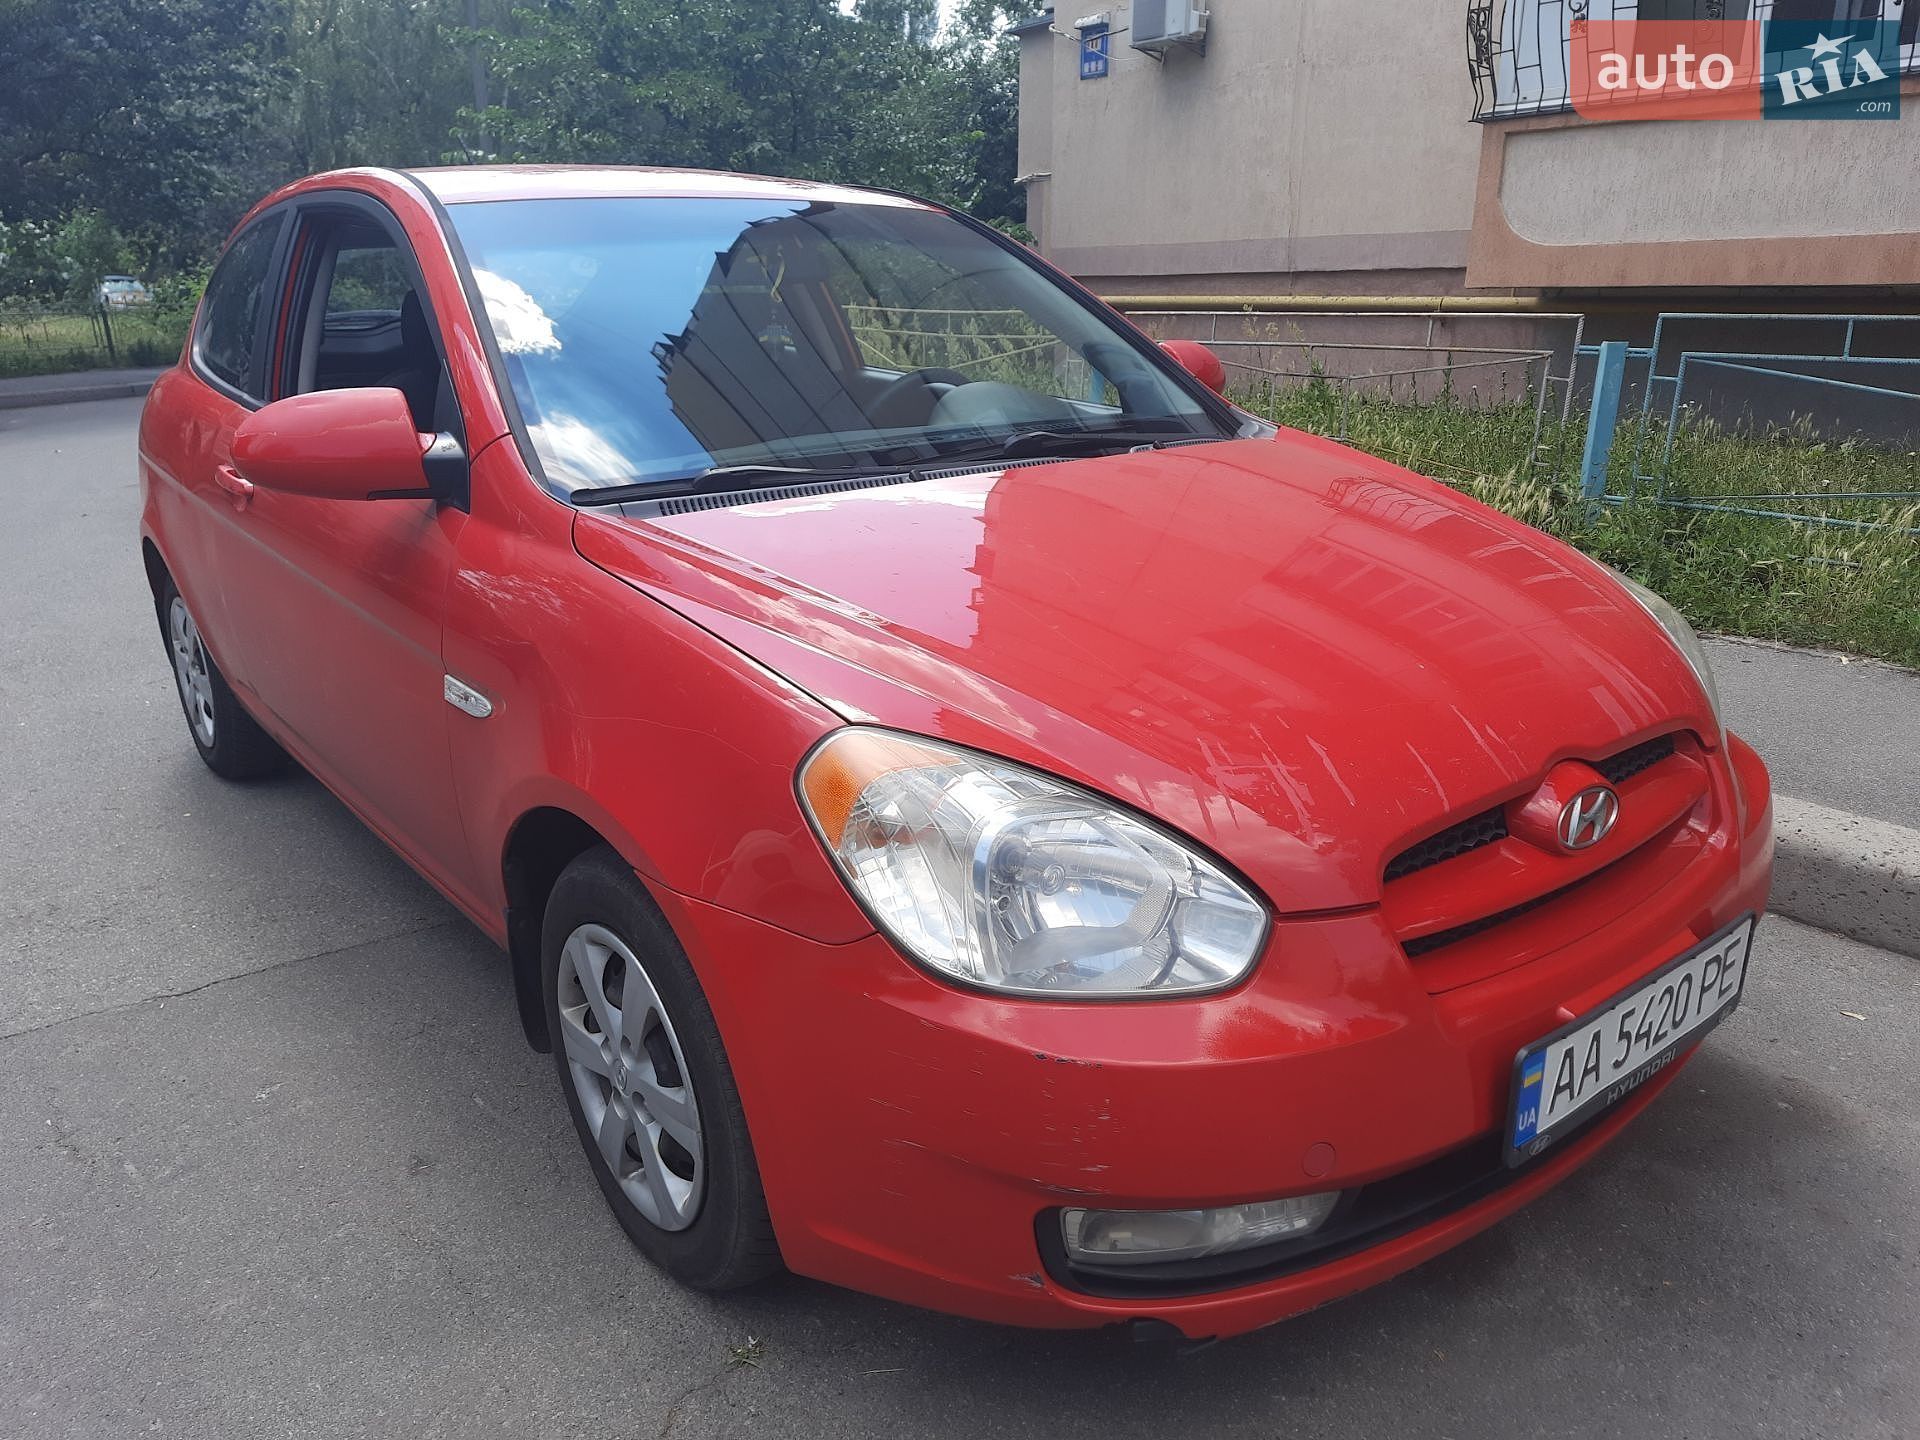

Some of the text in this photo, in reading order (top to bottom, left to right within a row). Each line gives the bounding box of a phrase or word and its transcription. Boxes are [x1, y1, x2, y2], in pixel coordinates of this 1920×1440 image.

[1547, 937, 1741, 1115] AA 5420 PE
[1606, 1048, 1676, 1105] HYUNDAI
[1518, 1107, 1537, 1132] UA
